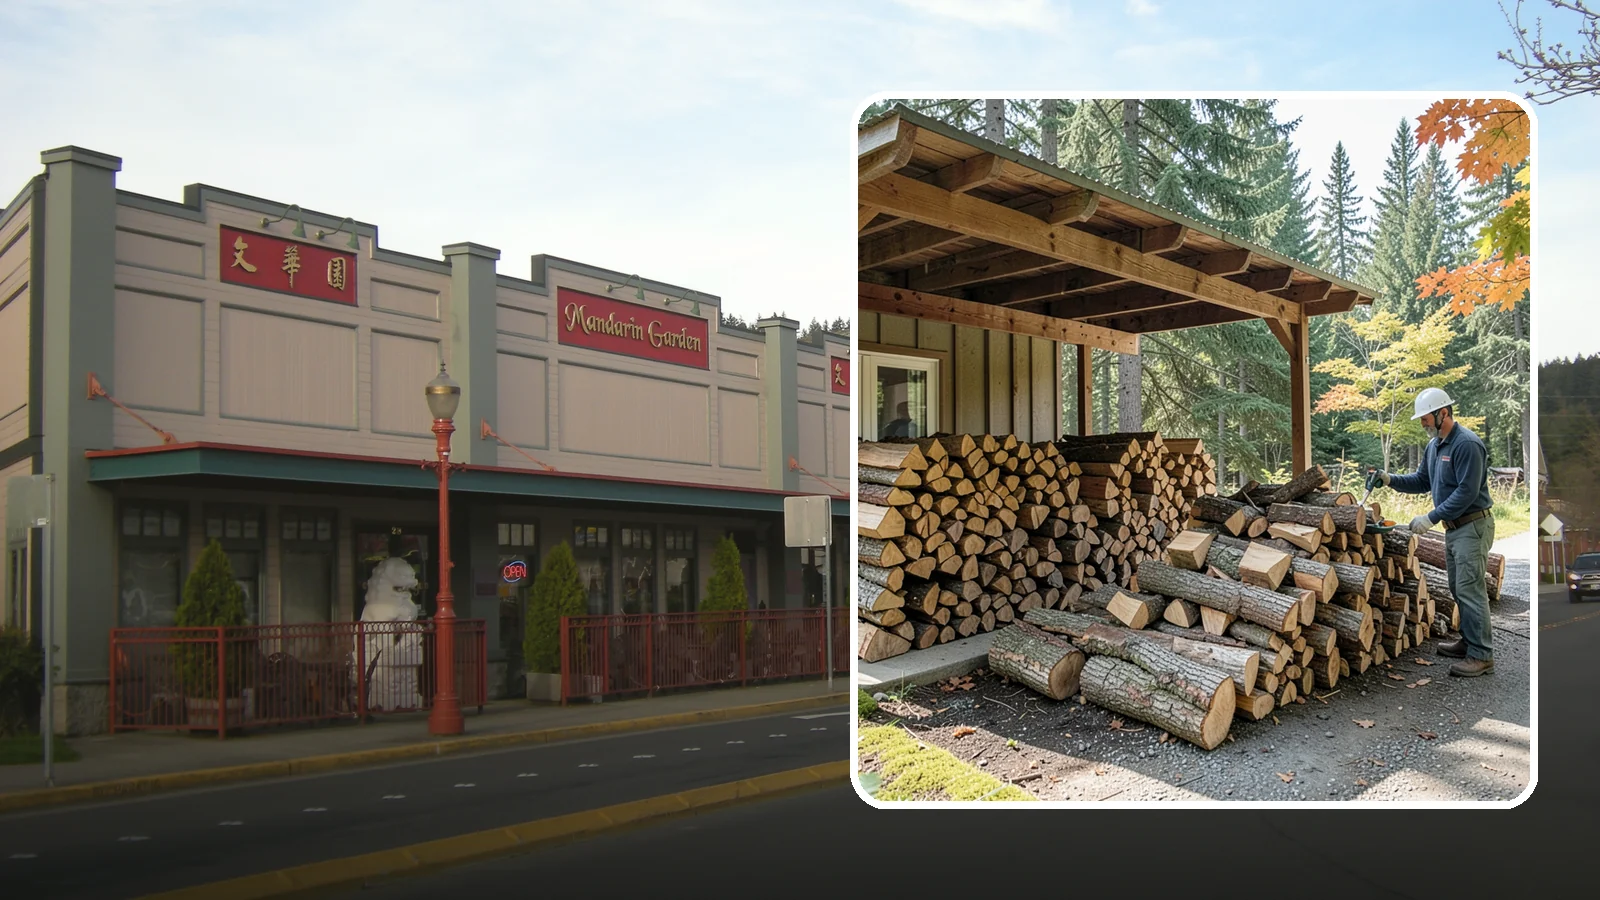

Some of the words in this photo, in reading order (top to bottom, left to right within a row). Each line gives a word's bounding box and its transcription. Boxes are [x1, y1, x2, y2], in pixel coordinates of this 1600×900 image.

[231, 236, 346, 290] 文華園
[564, 302, 644, 341] Mandarin
[648, 320, 701, 352] Garden
[503, 565, 527, 578] OPEN
